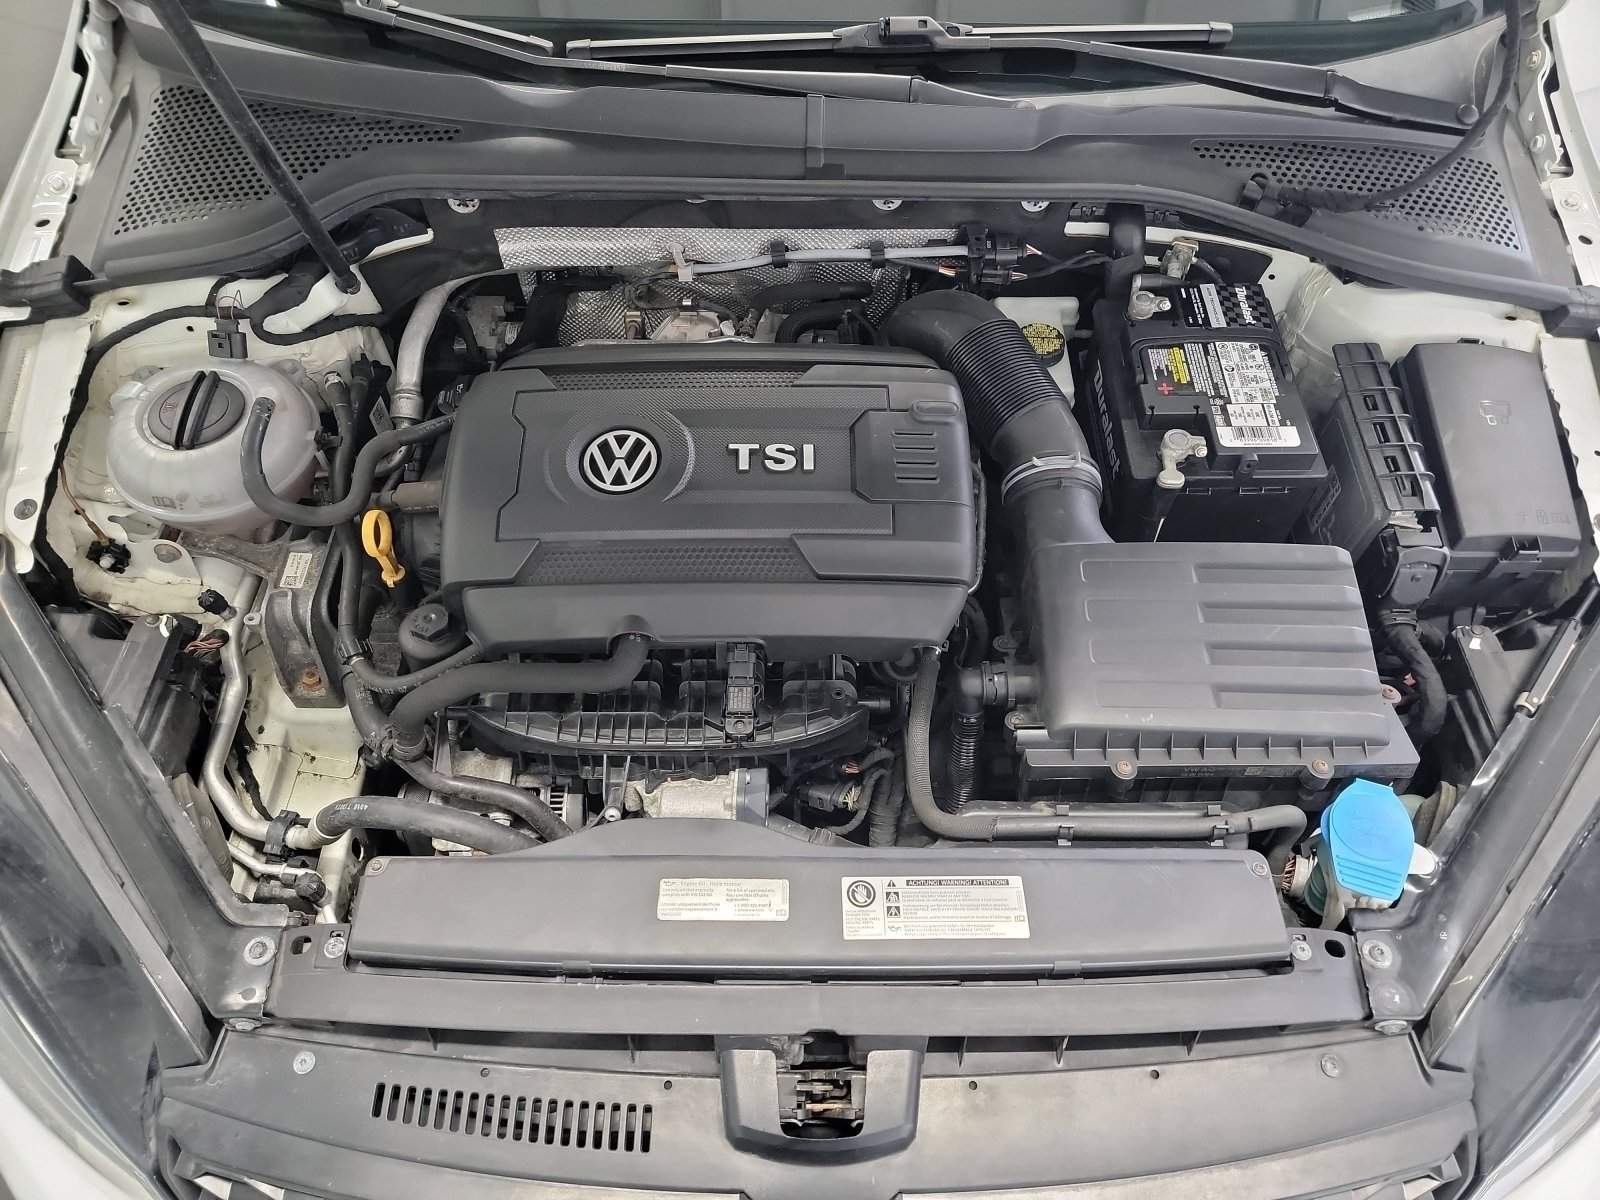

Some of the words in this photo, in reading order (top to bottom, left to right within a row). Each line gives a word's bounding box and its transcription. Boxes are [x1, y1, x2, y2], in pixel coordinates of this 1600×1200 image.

[1235, 286, 1256, 325] Duralast
[1094, 358, 1120, 480] Duralast
[584, 430, 657, 491] VW
[727, 443, 815, 472] TSI
